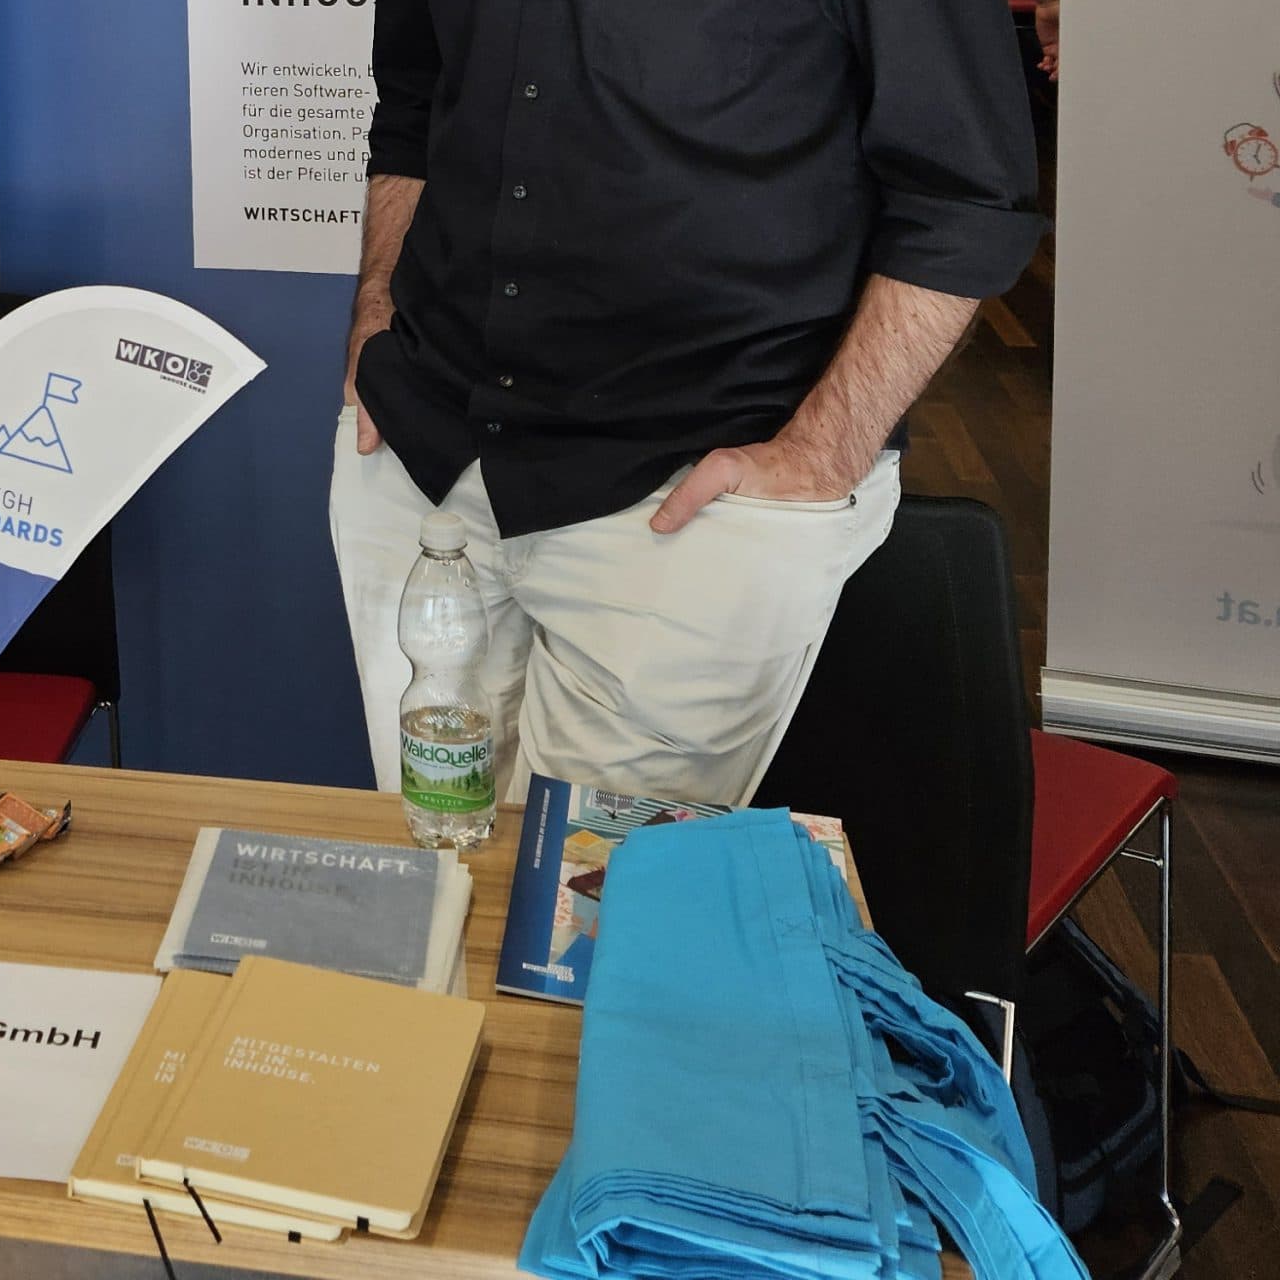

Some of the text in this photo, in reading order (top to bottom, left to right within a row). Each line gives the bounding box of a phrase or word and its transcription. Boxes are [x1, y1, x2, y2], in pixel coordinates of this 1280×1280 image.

[241, 62, 268, 76] Wir
[273, 63, 362, 79] entwickeln,
[242, 83, 370, 98] rieren Software-
[242, 104, 265, 118] für
[270, 104, 292, 118] die
[297, 107, 365, 121] gesamte
[243, 124, 346, 142] Organisation.
[243, 147, 321, 160] modernes
[327, 148, 356, 161] und
[244, 166, 262, 180] ist
[267, 166, 293, 180] der
[298, 168, 348, 182] Pfeiler
[244, 207, 361, 224] WIRTSCHAFT
[120, 341, 185, 374] WKO
[401, 730, 487, 768] WaldQuelle
[237, 842, 410, 875] WIRTSCHAFT
[229, 1046, 260, 1059] IST
[233, 1036, 380, 1073] MITGESTALTEN
